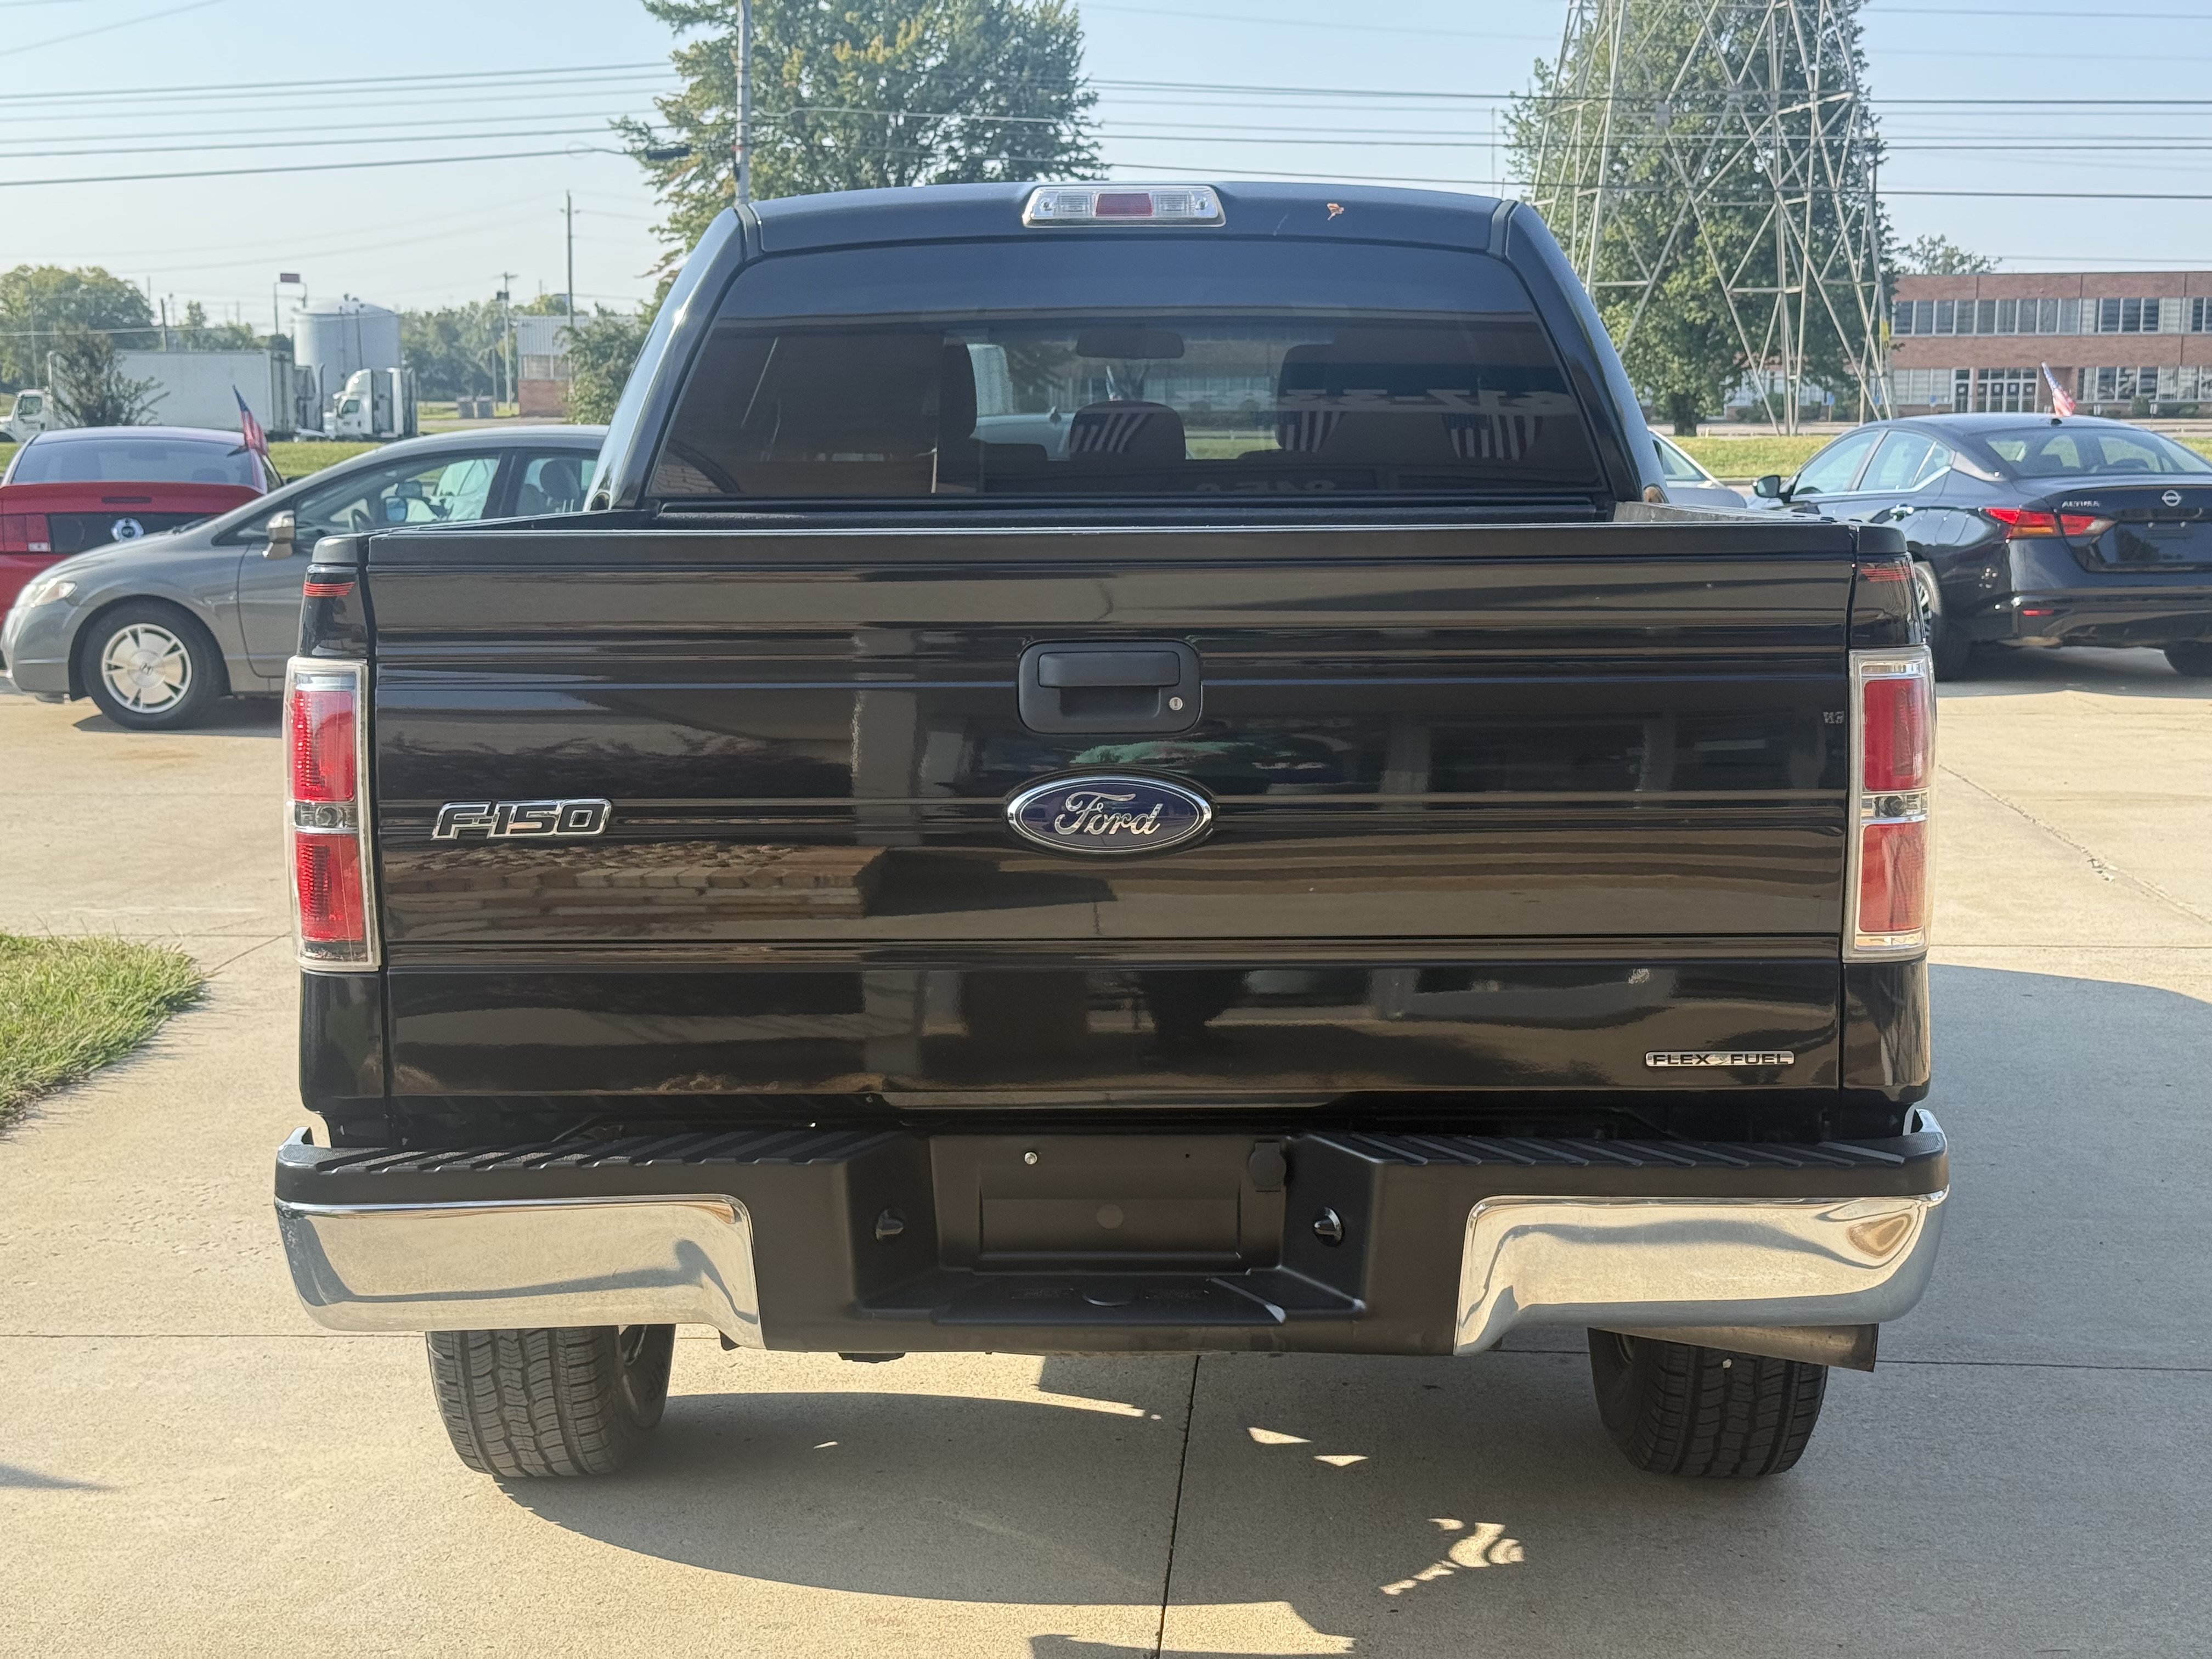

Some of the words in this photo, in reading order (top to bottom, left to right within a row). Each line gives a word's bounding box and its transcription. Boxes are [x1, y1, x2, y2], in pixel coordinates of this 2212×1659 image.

[430, 798, 613, 840] F-150
[1054, 791, 1164, 836] Ford
[1652, 1054, 1711, 1065] FLEX
[1730, 1053, 1789, 1064] FUEL
